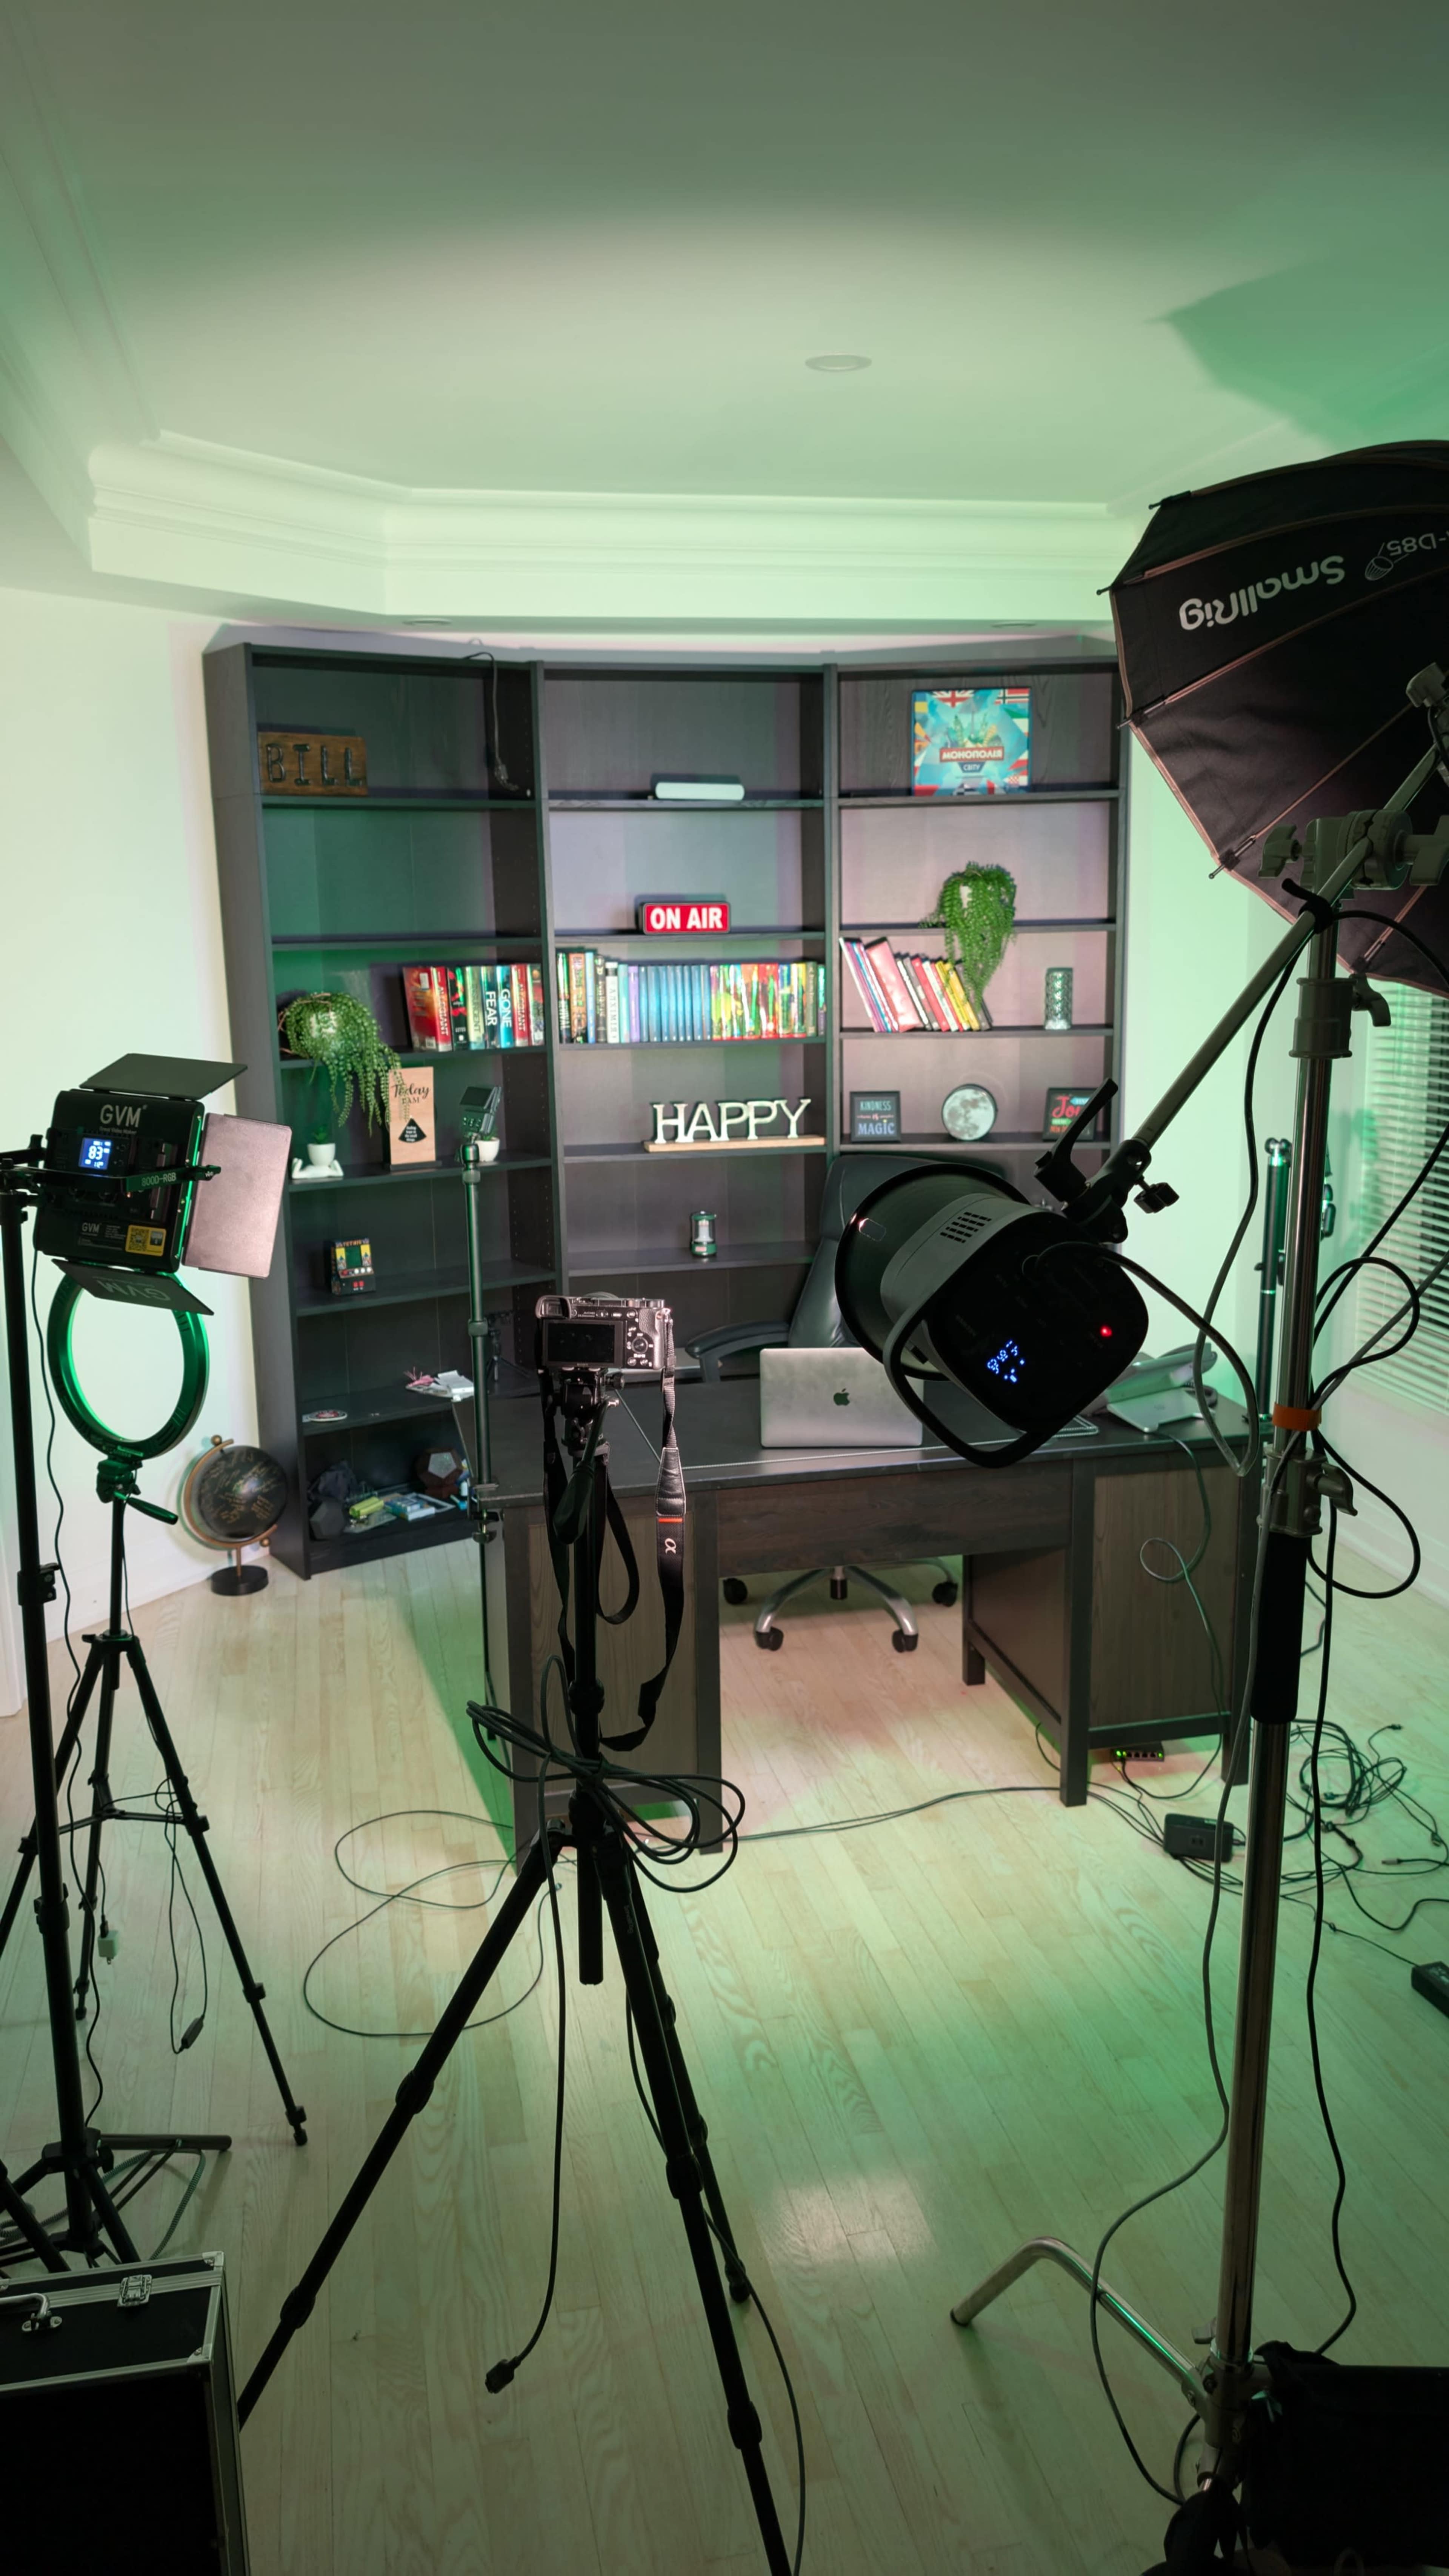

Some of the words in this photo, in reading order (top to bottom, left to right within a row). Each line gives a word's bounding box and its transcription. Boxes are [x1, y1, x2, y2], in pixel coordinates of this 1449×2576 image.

[1179, 555, 1345, 630] SmallRig
[266, 743, 363, 786] BILL
[651, 907, 681, 929] ON
[687, 907, 723, 929] AIR
[485, 991, 497, 1026] FEAR
[501, 988, 512, 1028] GONE
[100, 1104, 142, 1128] GVM
[860, 1100, 892, 1111] KINDNESS
[653, 1098, 811, 1144] HAPPY
[88, 1145, 103, 1160] 83
[82, 1223, 100, 1233] GVM
